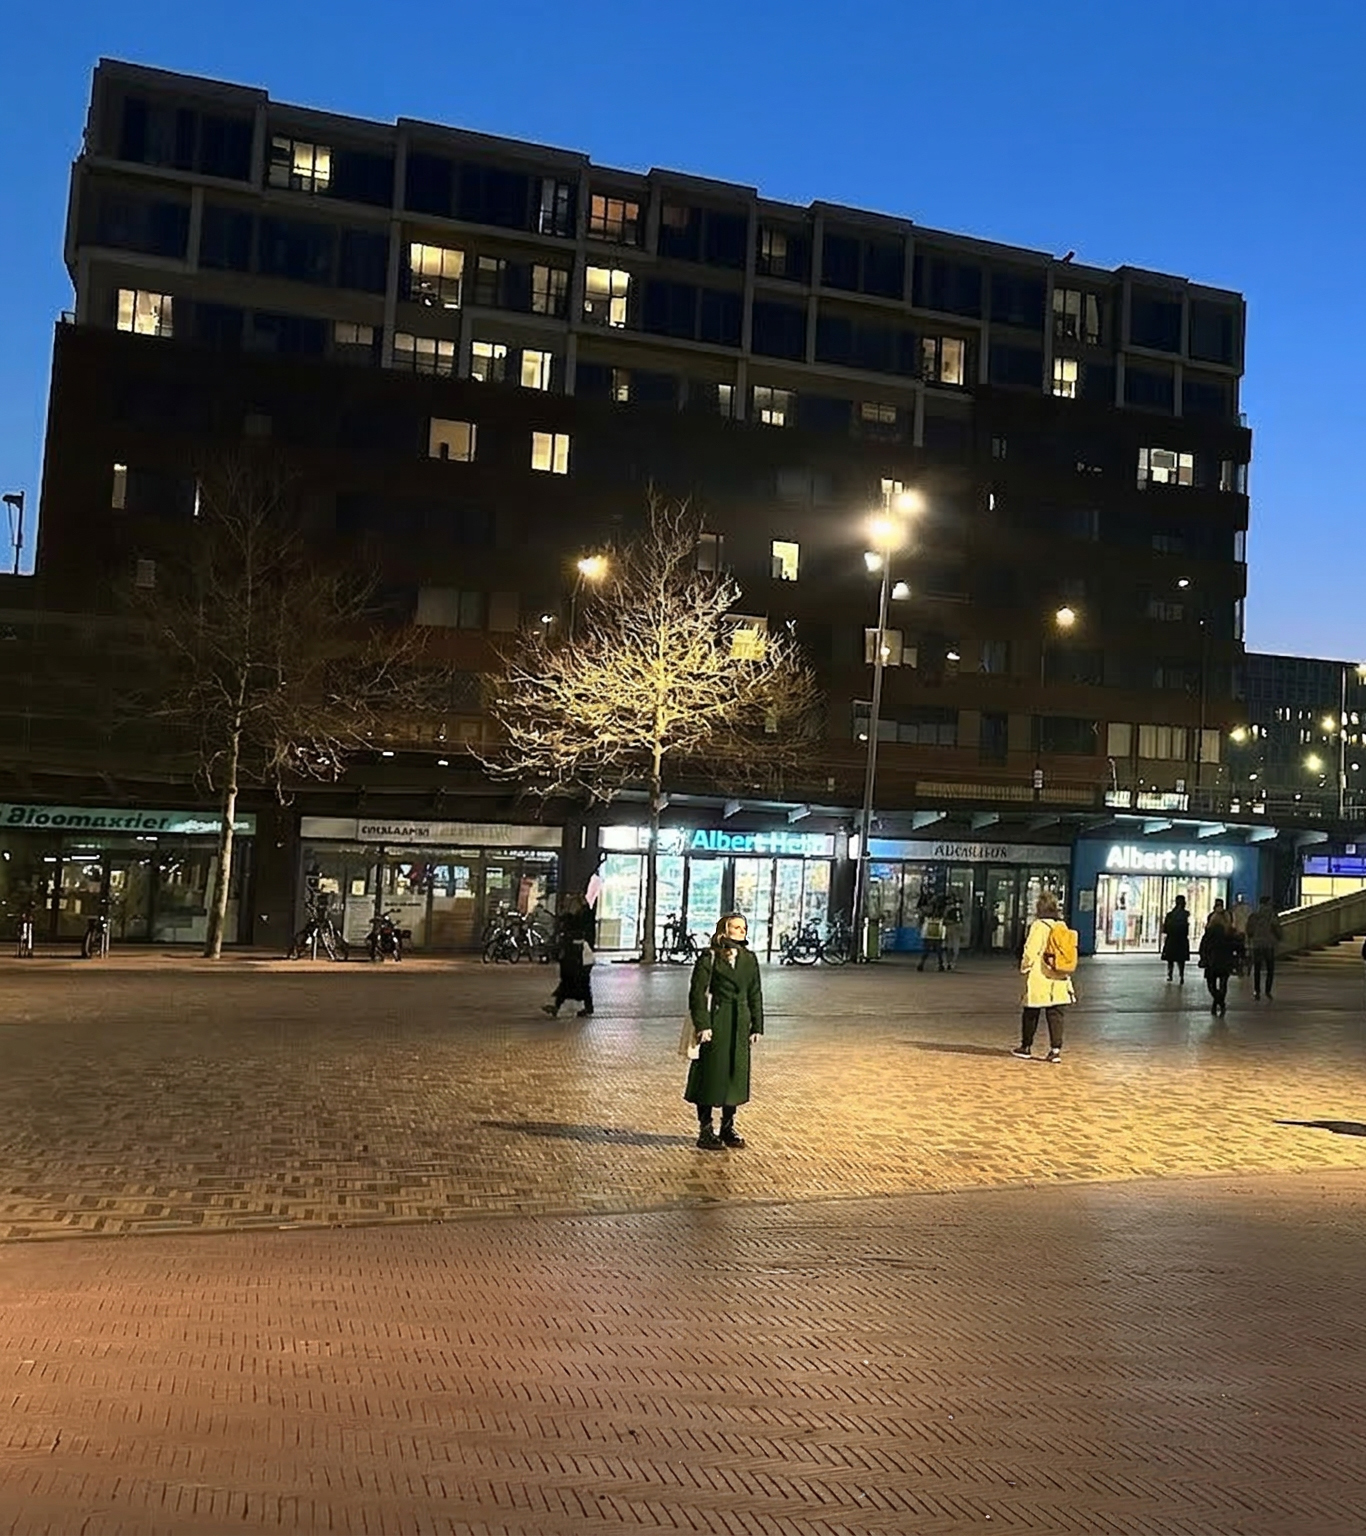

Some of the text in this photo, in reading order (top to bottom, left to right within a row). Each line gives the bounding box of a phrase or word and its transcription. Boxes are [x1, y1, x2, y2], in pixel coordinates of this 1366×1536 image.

[691, 830, 766, 852] Albert
[1106, 846, 1234, 875] Albert Heijn
